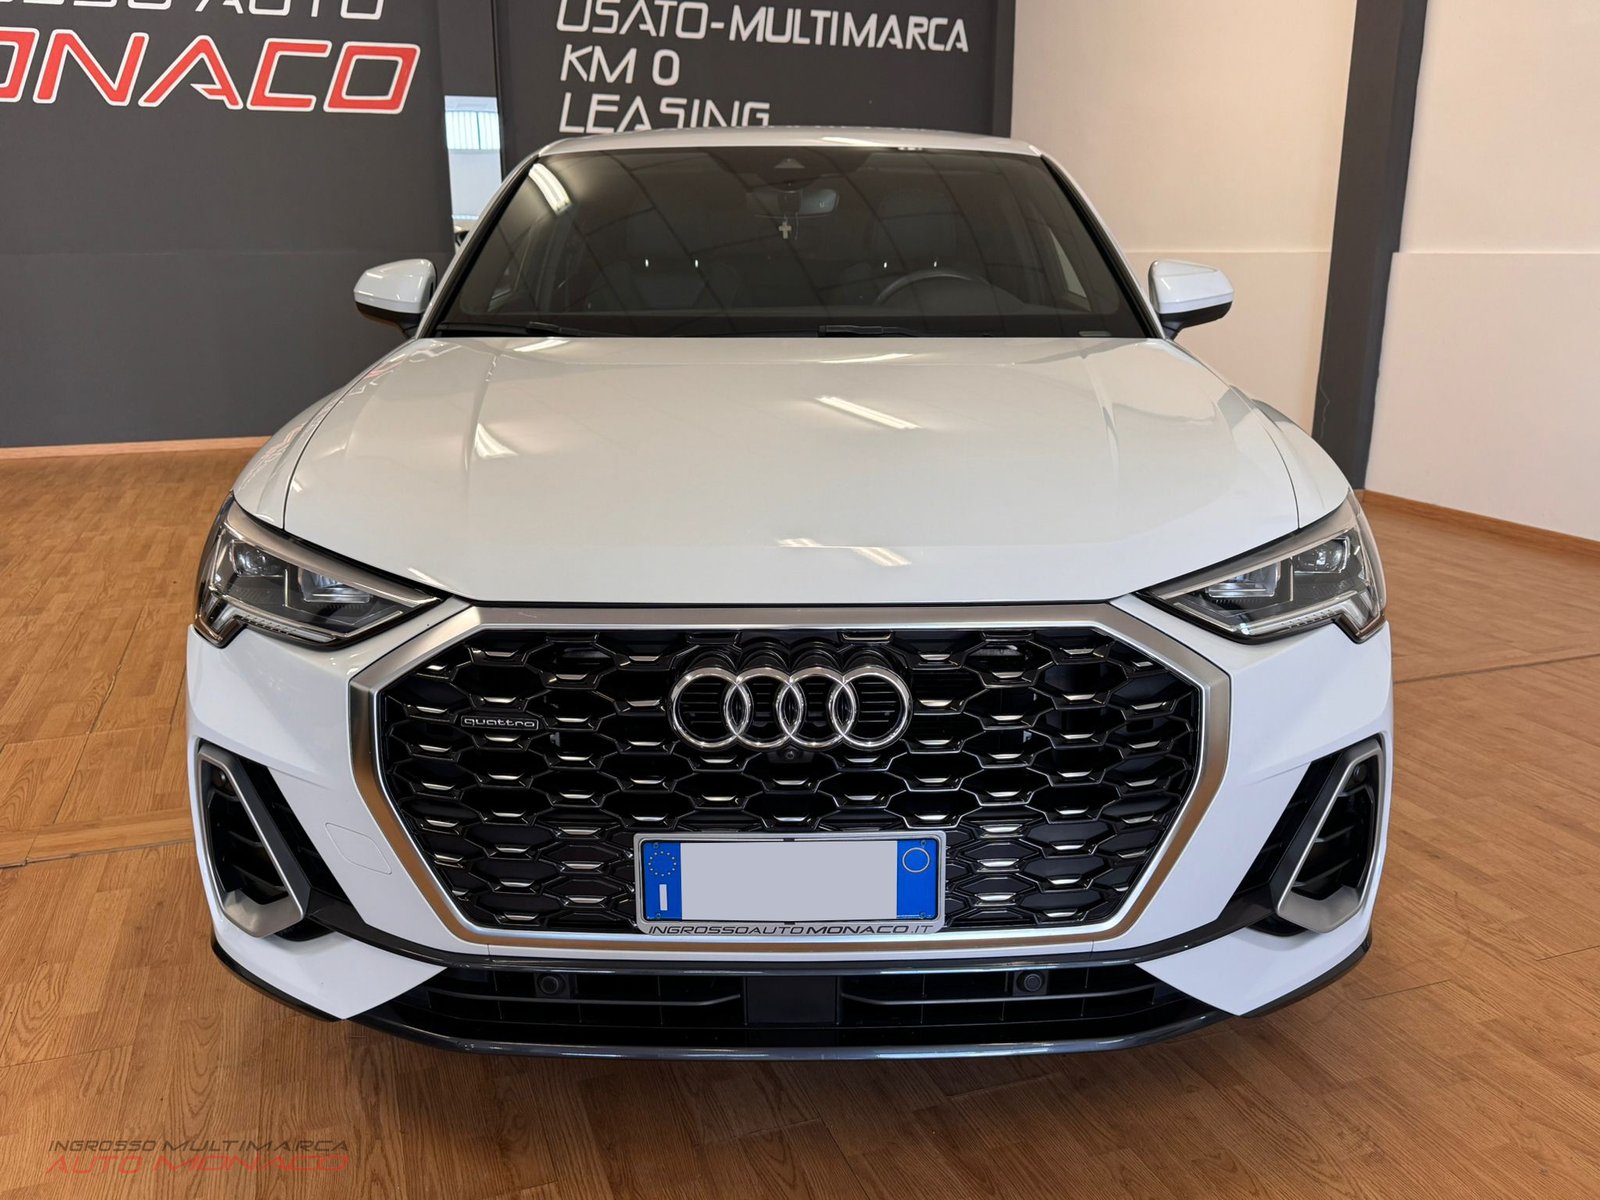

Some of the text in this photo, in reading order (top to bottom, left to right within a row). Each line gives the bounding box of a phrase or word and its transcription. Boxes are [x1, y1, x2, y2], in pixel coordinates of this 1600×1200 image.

[556, 0, 969, 52] USATO-MULTIMARCA
[560, 44, 638, 83] KM
[559, 92, 770, 133] LEASING
[464, 718, 535, 728] quattro
